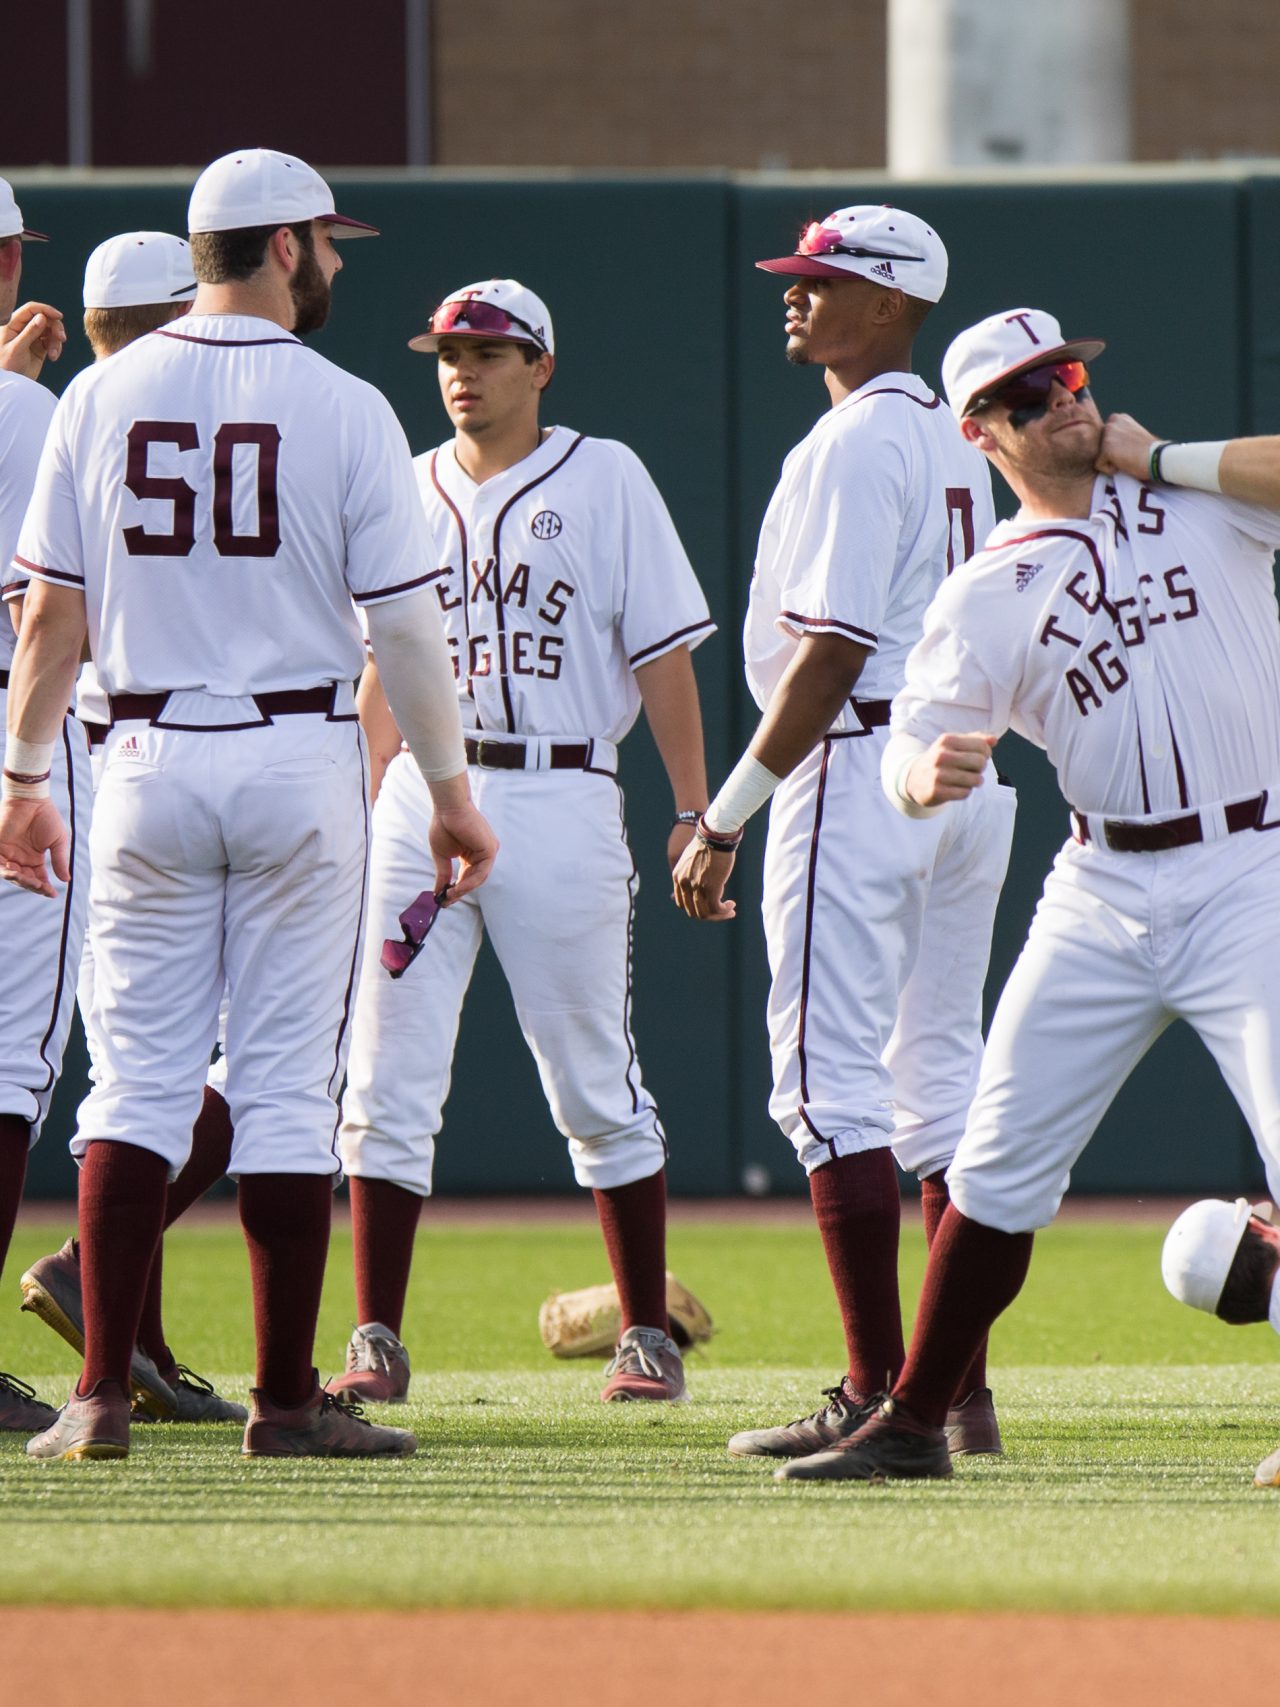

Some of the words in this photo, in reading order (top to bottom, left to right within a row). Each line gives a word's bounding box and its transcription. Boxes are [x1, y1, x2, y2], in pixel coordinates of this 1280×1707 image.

[1005, 313, 1040, 345] T
[122, 421, 282, 557] 50
[532, 511, 562, 539] SEC
[435, 558, 575, 626] EXAS
[447, 631, 564, 680] GIES
[1065, 565, 1199, 716] AGGES
